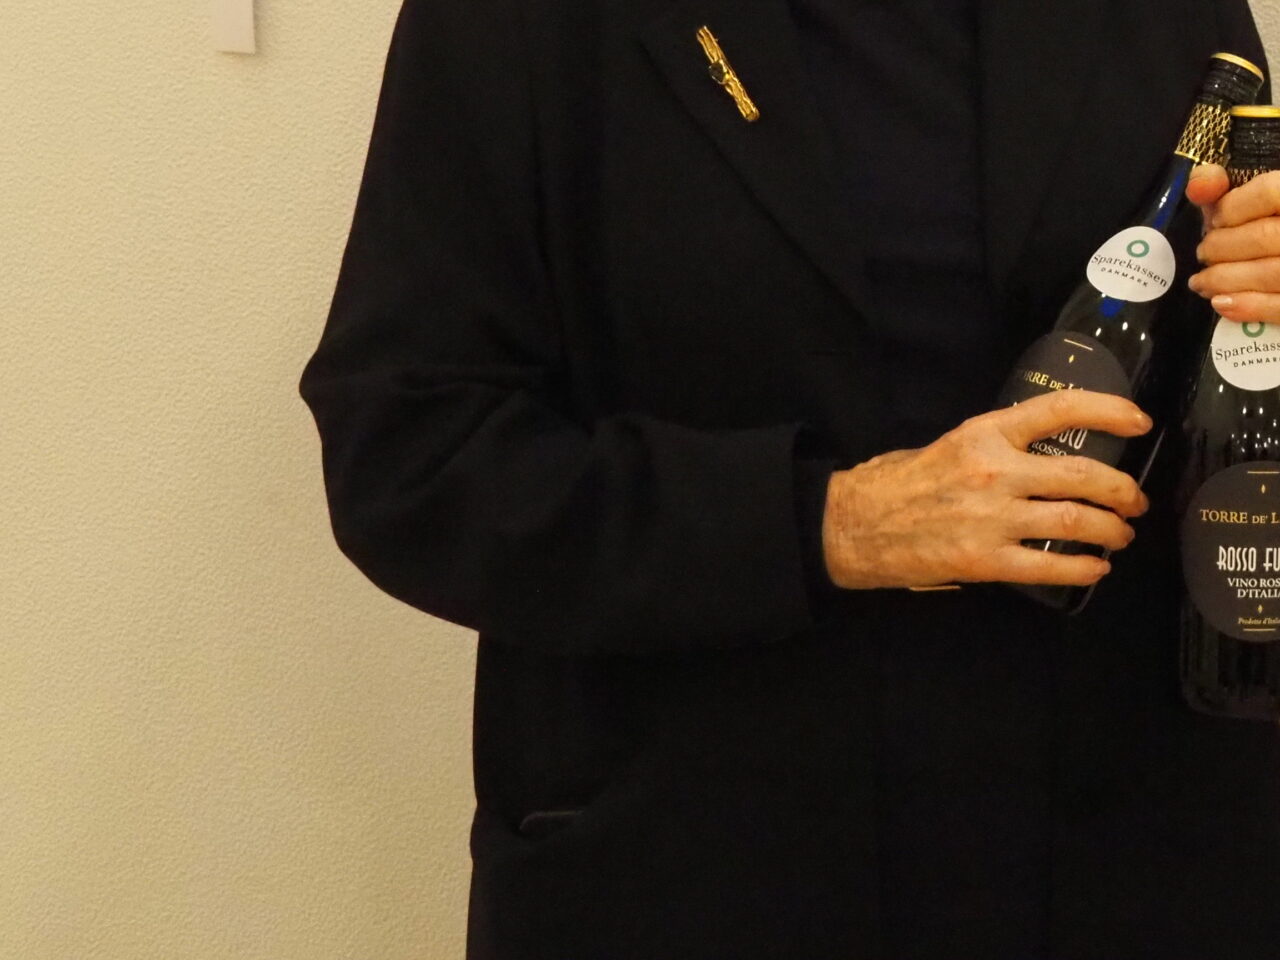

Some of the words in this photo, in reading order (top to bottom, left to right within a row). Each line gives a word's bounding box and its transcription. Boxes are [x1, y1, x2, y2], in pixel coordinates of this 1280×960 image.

[1091, 254, 1167, 287] Sparekassen
[1101, 267, 1149, 287] DANMARK
[1200, 508, 1248, 524] TORRE
[1216, 545, 1257, 572] ROSSO
[1227, 577, 1257, 588] VINO
